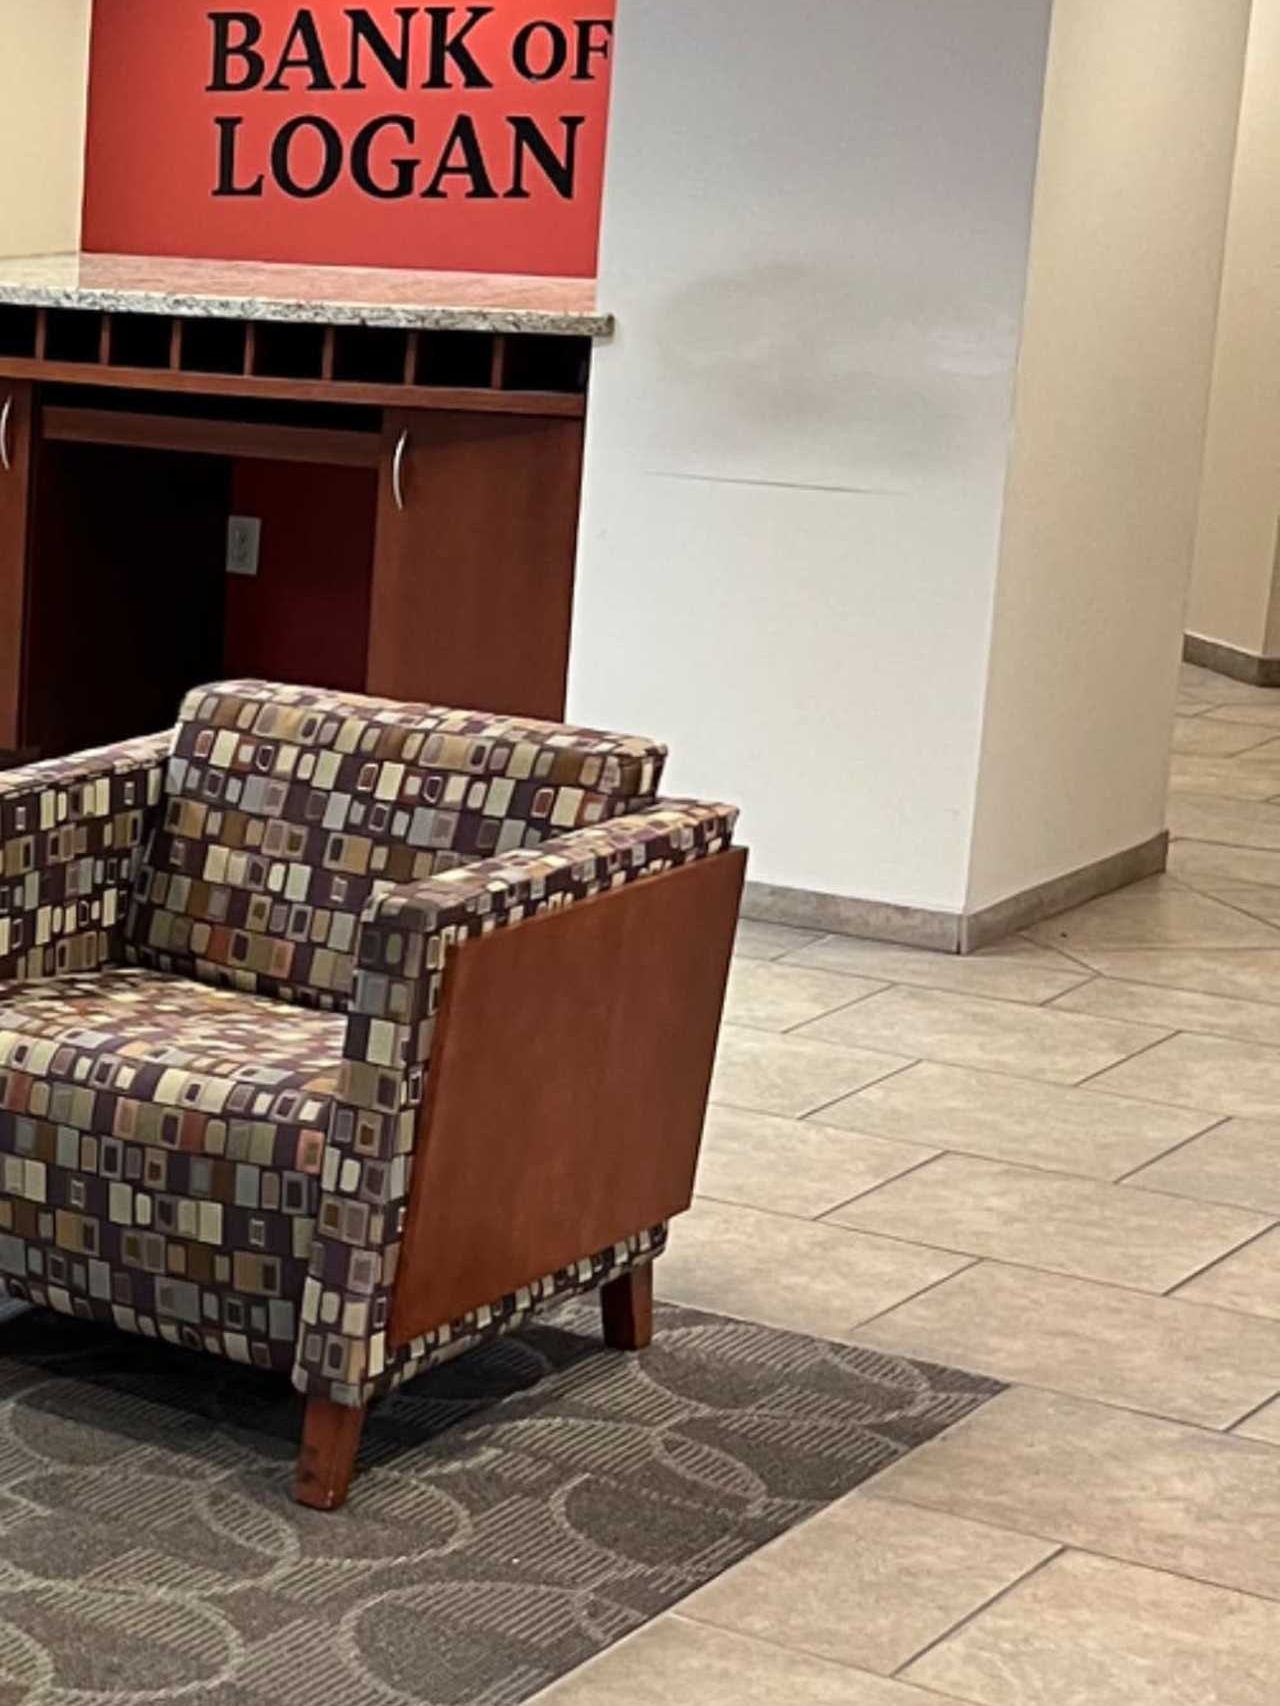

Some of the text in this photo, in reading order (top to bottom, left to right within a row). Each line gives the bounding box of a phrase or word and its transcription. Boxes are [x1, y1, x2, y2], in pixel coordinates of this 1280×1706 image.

[206, 7, 613, 91] BANK OF
[212, 114, 585, 199] LOGAN
